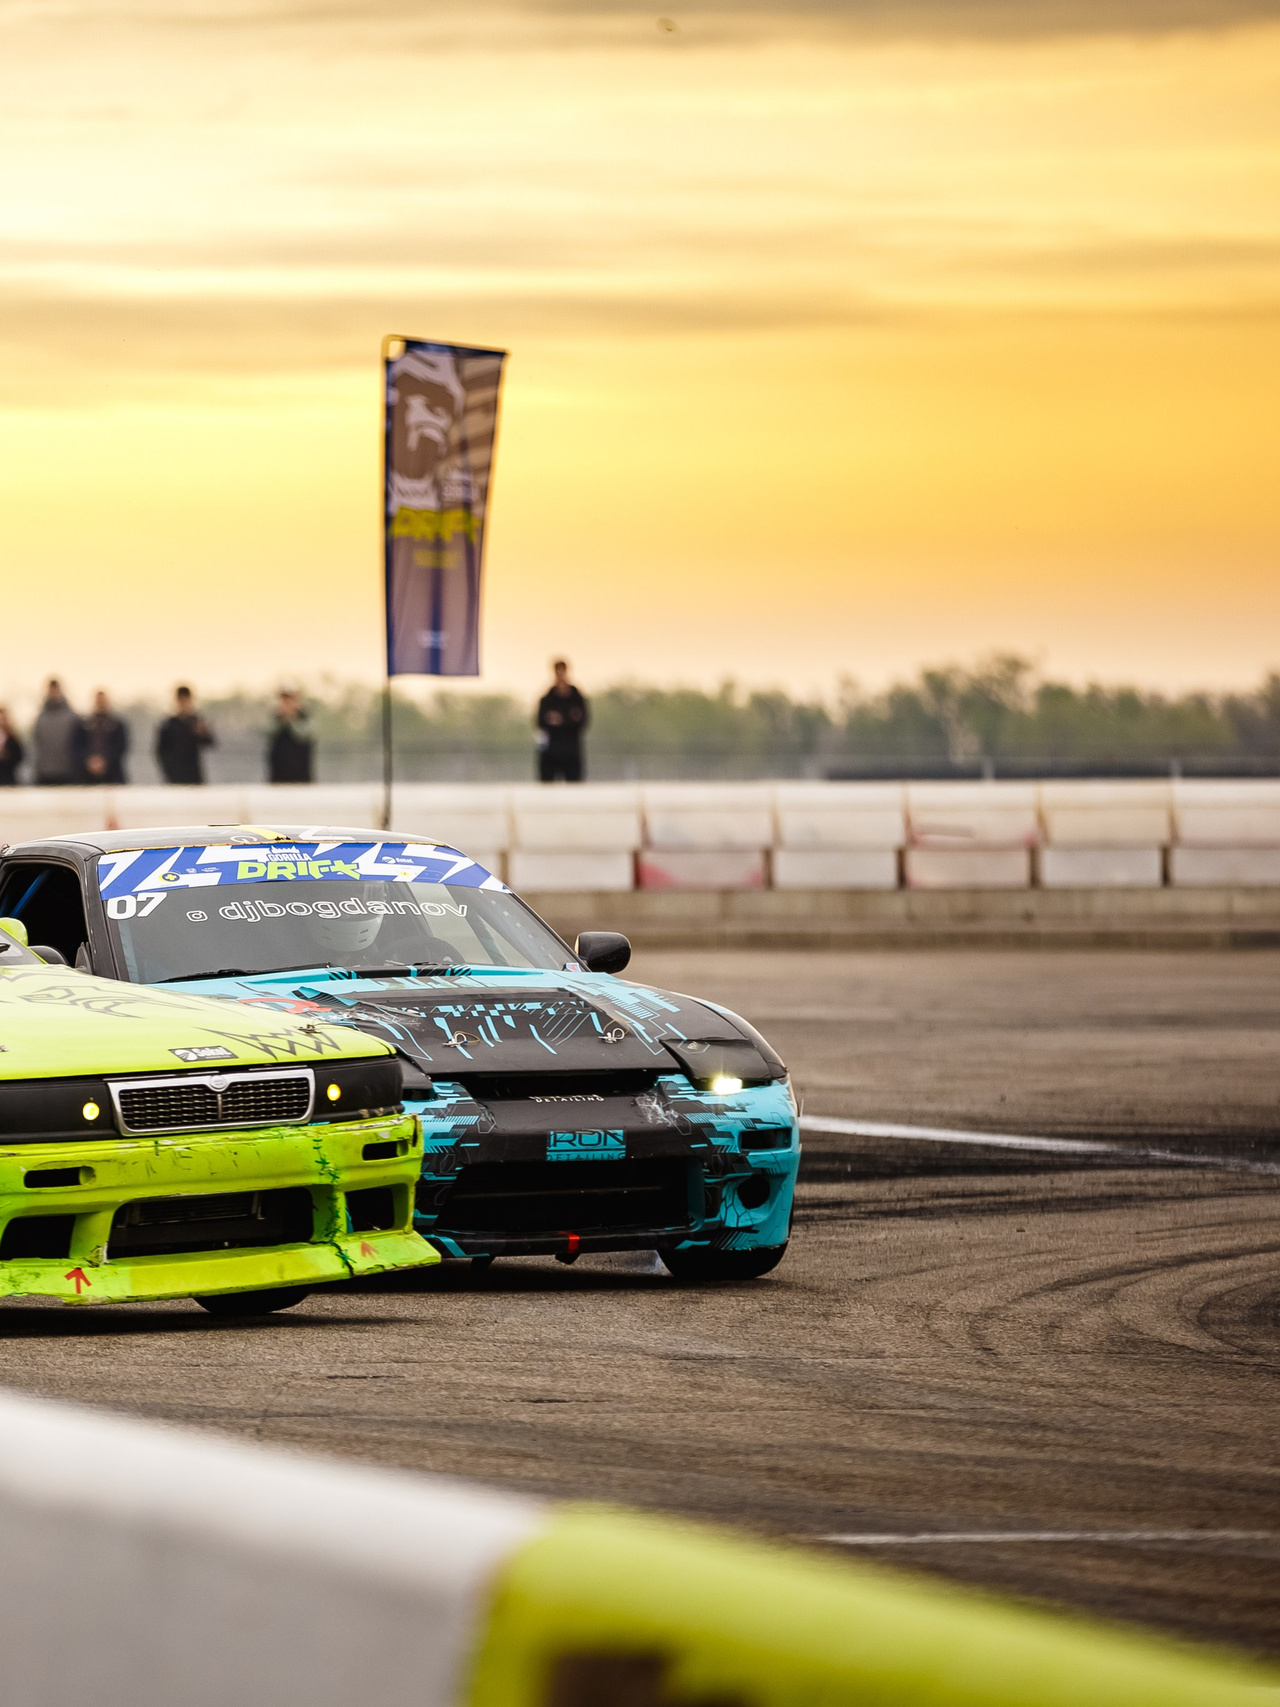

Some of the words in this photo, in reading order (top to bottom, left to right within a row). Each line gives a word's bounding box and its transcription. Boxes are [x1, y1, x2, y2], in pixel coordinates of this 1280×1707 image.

[268, 853, 313, 861] GORILLA
[237, 859, 360, 880] DRIFT
[107, 892, 167, 920] 07
[220, 897, 467, 922] djbogdanov
[546, 1128, 627, 1147] IRON
